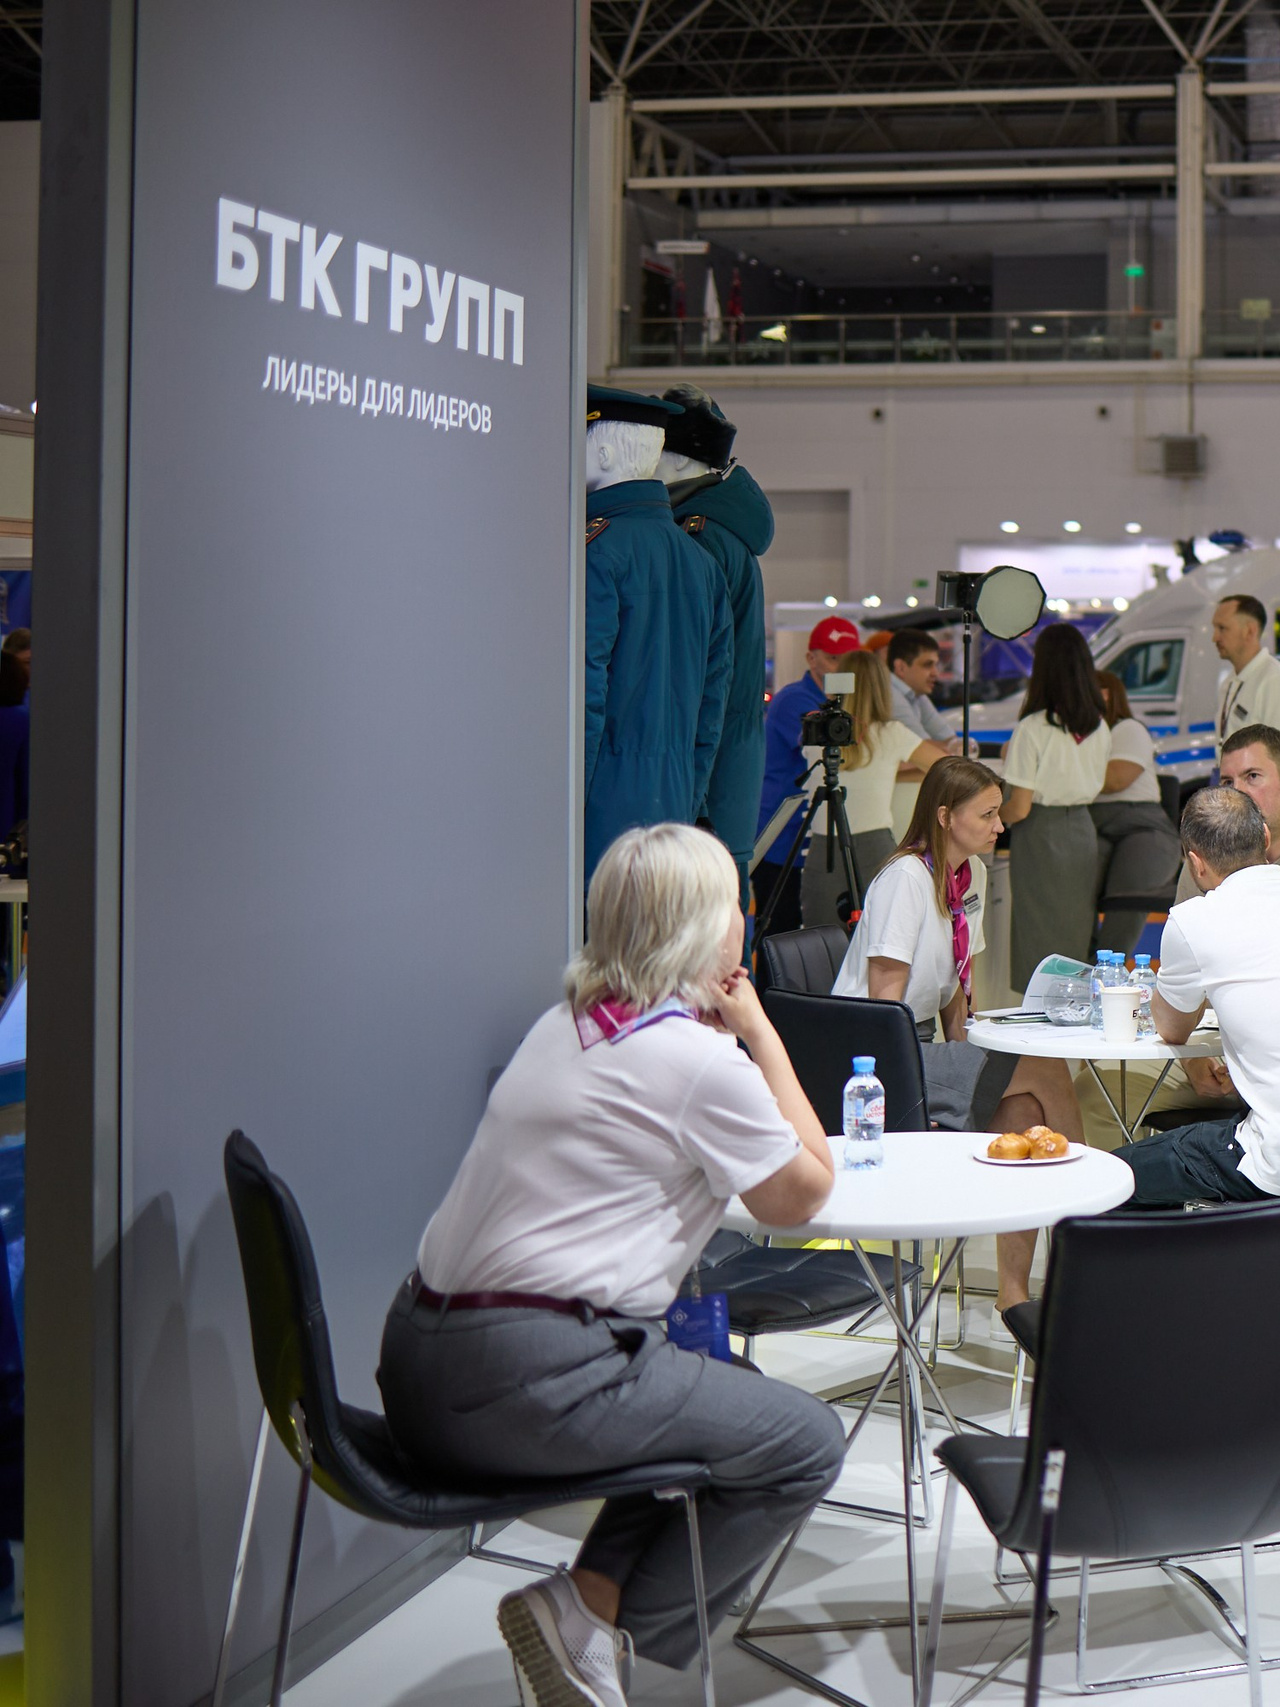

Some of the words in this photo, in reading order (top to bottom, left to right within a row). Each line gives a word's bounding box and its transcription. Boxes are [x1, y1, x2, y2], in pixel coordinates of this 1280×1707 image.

[216, 196, 344, 318] БТК
[354, 241, 525, 366] ГРУПП
[262, 355, 357, 406] ЛИДЕРЫ
[360, 377, 404, 417] ДЛЯ
[407, 387, 493, 434] ЛИДЕРОВ
